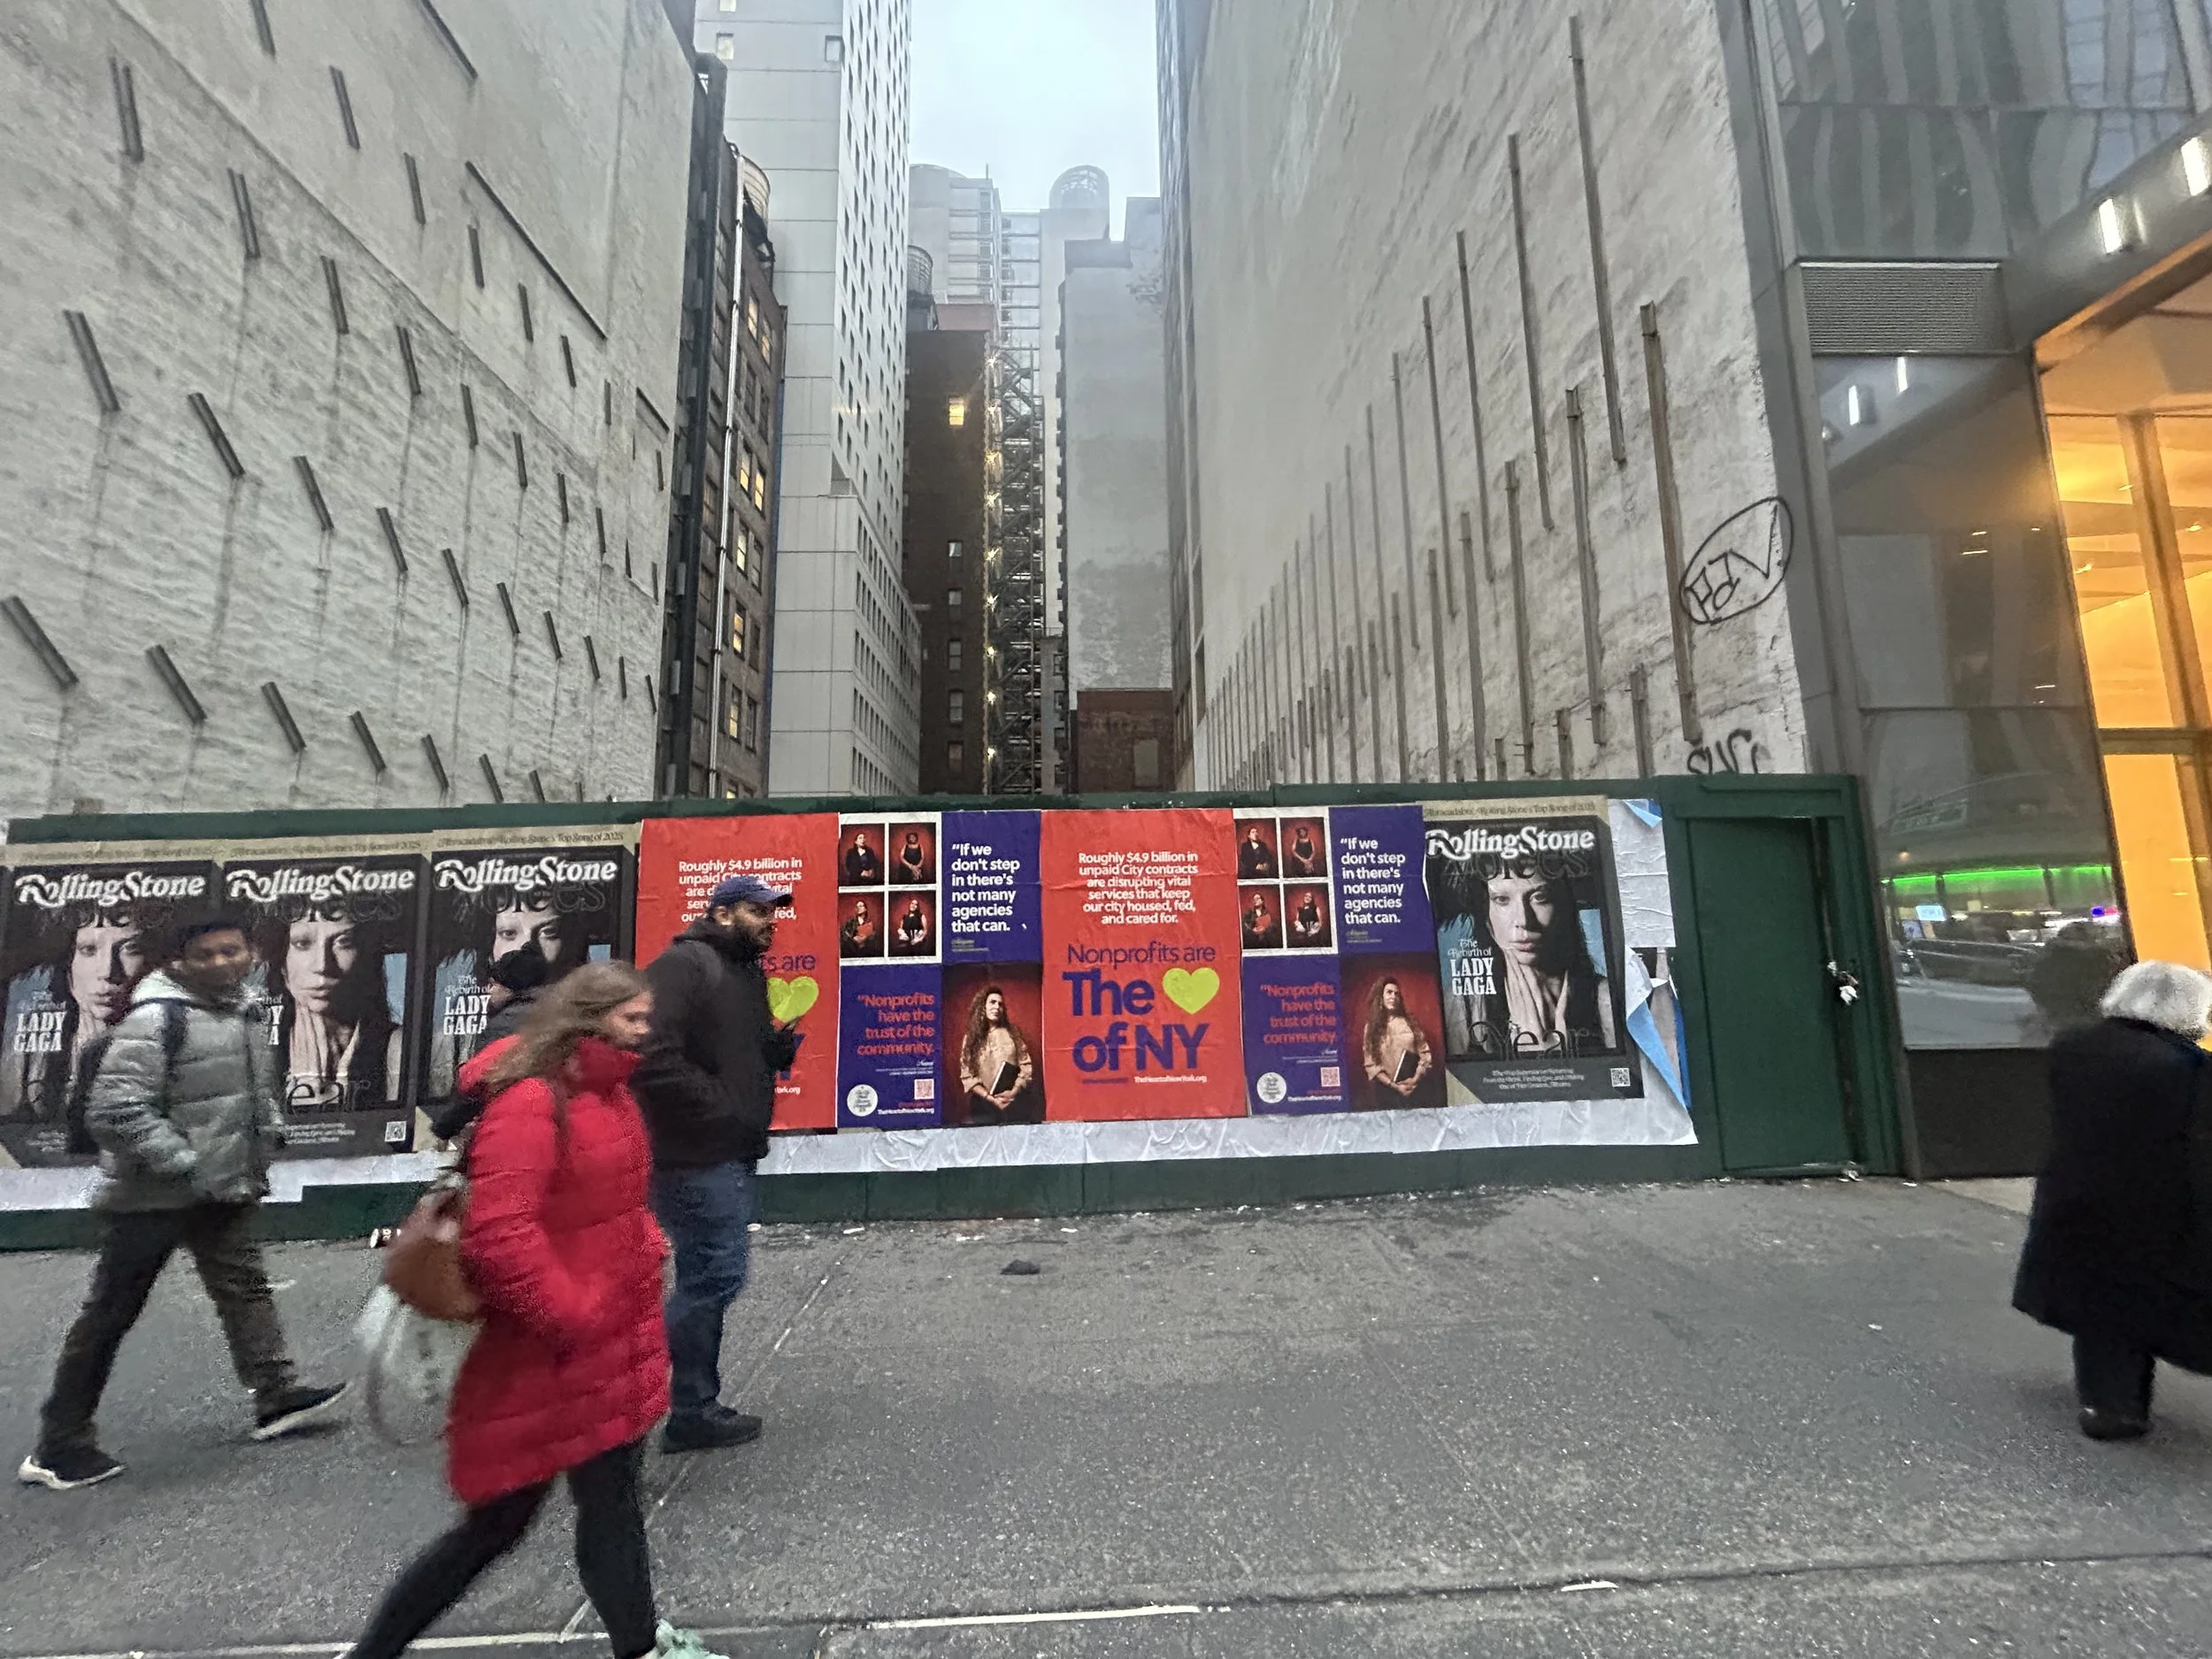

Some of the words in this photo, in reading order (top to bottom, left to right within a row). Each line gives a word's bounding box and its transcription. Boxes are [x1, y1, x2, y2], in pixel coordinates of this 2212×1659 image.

[972, 846, 992, 856] we
[1359, 840, 1379, 849] we
[679, 860, 726, 873] Roughly
[728, 859, 751, 871] $4.9
[753, 858, 789, 870] billion
[791, 857, 803, 868] in
[951, 858, 988, 872] don't
[990, 858, 1021, 873] step
[1079, 852, 1125, 865] Roughly
[1126, 852, 1148, 864] $4.9
[1151, 851, 1185, 863] billion
[1187, 851, 1198, 862] in
[1341, 852, 1376, 864] don't
[1378, 853, 1406, 867] step
[1079, 864, 1119, 877] unpaid
[1121, 864, 1143, 876] City
[1145, 864, 1198, 874] contracts
[1342, 867, 1355, 879] in
[1356, 867, 1401, 879] there's
[679, 872, 720, 887] unpaid
[952, 874, 964, 886] in
[967, 873, 1013, 886] there's
[1087, 879, 1105, 887] are
[1108, 876, 1165, 889] disrupting
[1167, 875, 1191, 886] vital
[686, 887, 705, 897] are
[952, 889, 975, 902] not
[978, 890, 1017, 903] many
[1088, 889, 1134, 900] services
[1136, 888, 1159, 899] that
[1162, 888, 1190, 902] keep
[1343, 883, 1366, 895] not
[1368, 883, 1404, 896] many
[1083, 903, 1103, 912] our
[1105, 901, 1125, 914] city
[1127, 900, 1172, 912] housed,
[1174, 899, 1195, 911] fed,
[1344, 896, 1402, 911] agencies
[951, 903, 1013, 920] agencies
[1102, 913, 1124, 925] and
[1125, 912, 1158, 924] cared
[1160, 912, 1179, 923] for.
[1345, 911, 1372, 925] that
[1374, 913, 1402, 924] can.
[951, 919, 980, 933] that
[982, 921, 1010, 932] can.
[1068, 941, 1179, 970] Nonprofits
[1183, 946, 1216, 963] are
[1483, 947, 1493, 956] of
[782, 954, 816, 972] are
[1450, 957, 1494, 977] LADY
[1062, 968, 1156, 1016] The
[1451, 977, 1497, 995] GAGA
[445, 995, 491, 1015] LADY
[1281, 999, 1312, 1012] have
[1314, 998, 1335, 1010] the
[17, 1011, 67, 1032] LADY
[879, 1010, 910, 1022] have
[913, 1009, 935, 1021] the
[1270, 1016, 1300, 1028] trust
[1301, 1014, 1314, 1026] of
[1315, 1013, 1336, 1026] the
[443, 1015, 488, 1035] GAGA
[865, 1026, 895, 1039] trust
[897, 1025, 911, 1037] of
[913, 1024, 935, 1037] the
[13, 1031, 63, 1052] GAGA
[1072, 1021, 1130, 1072] of
[1135, 1023, 1210, 1071] NY
